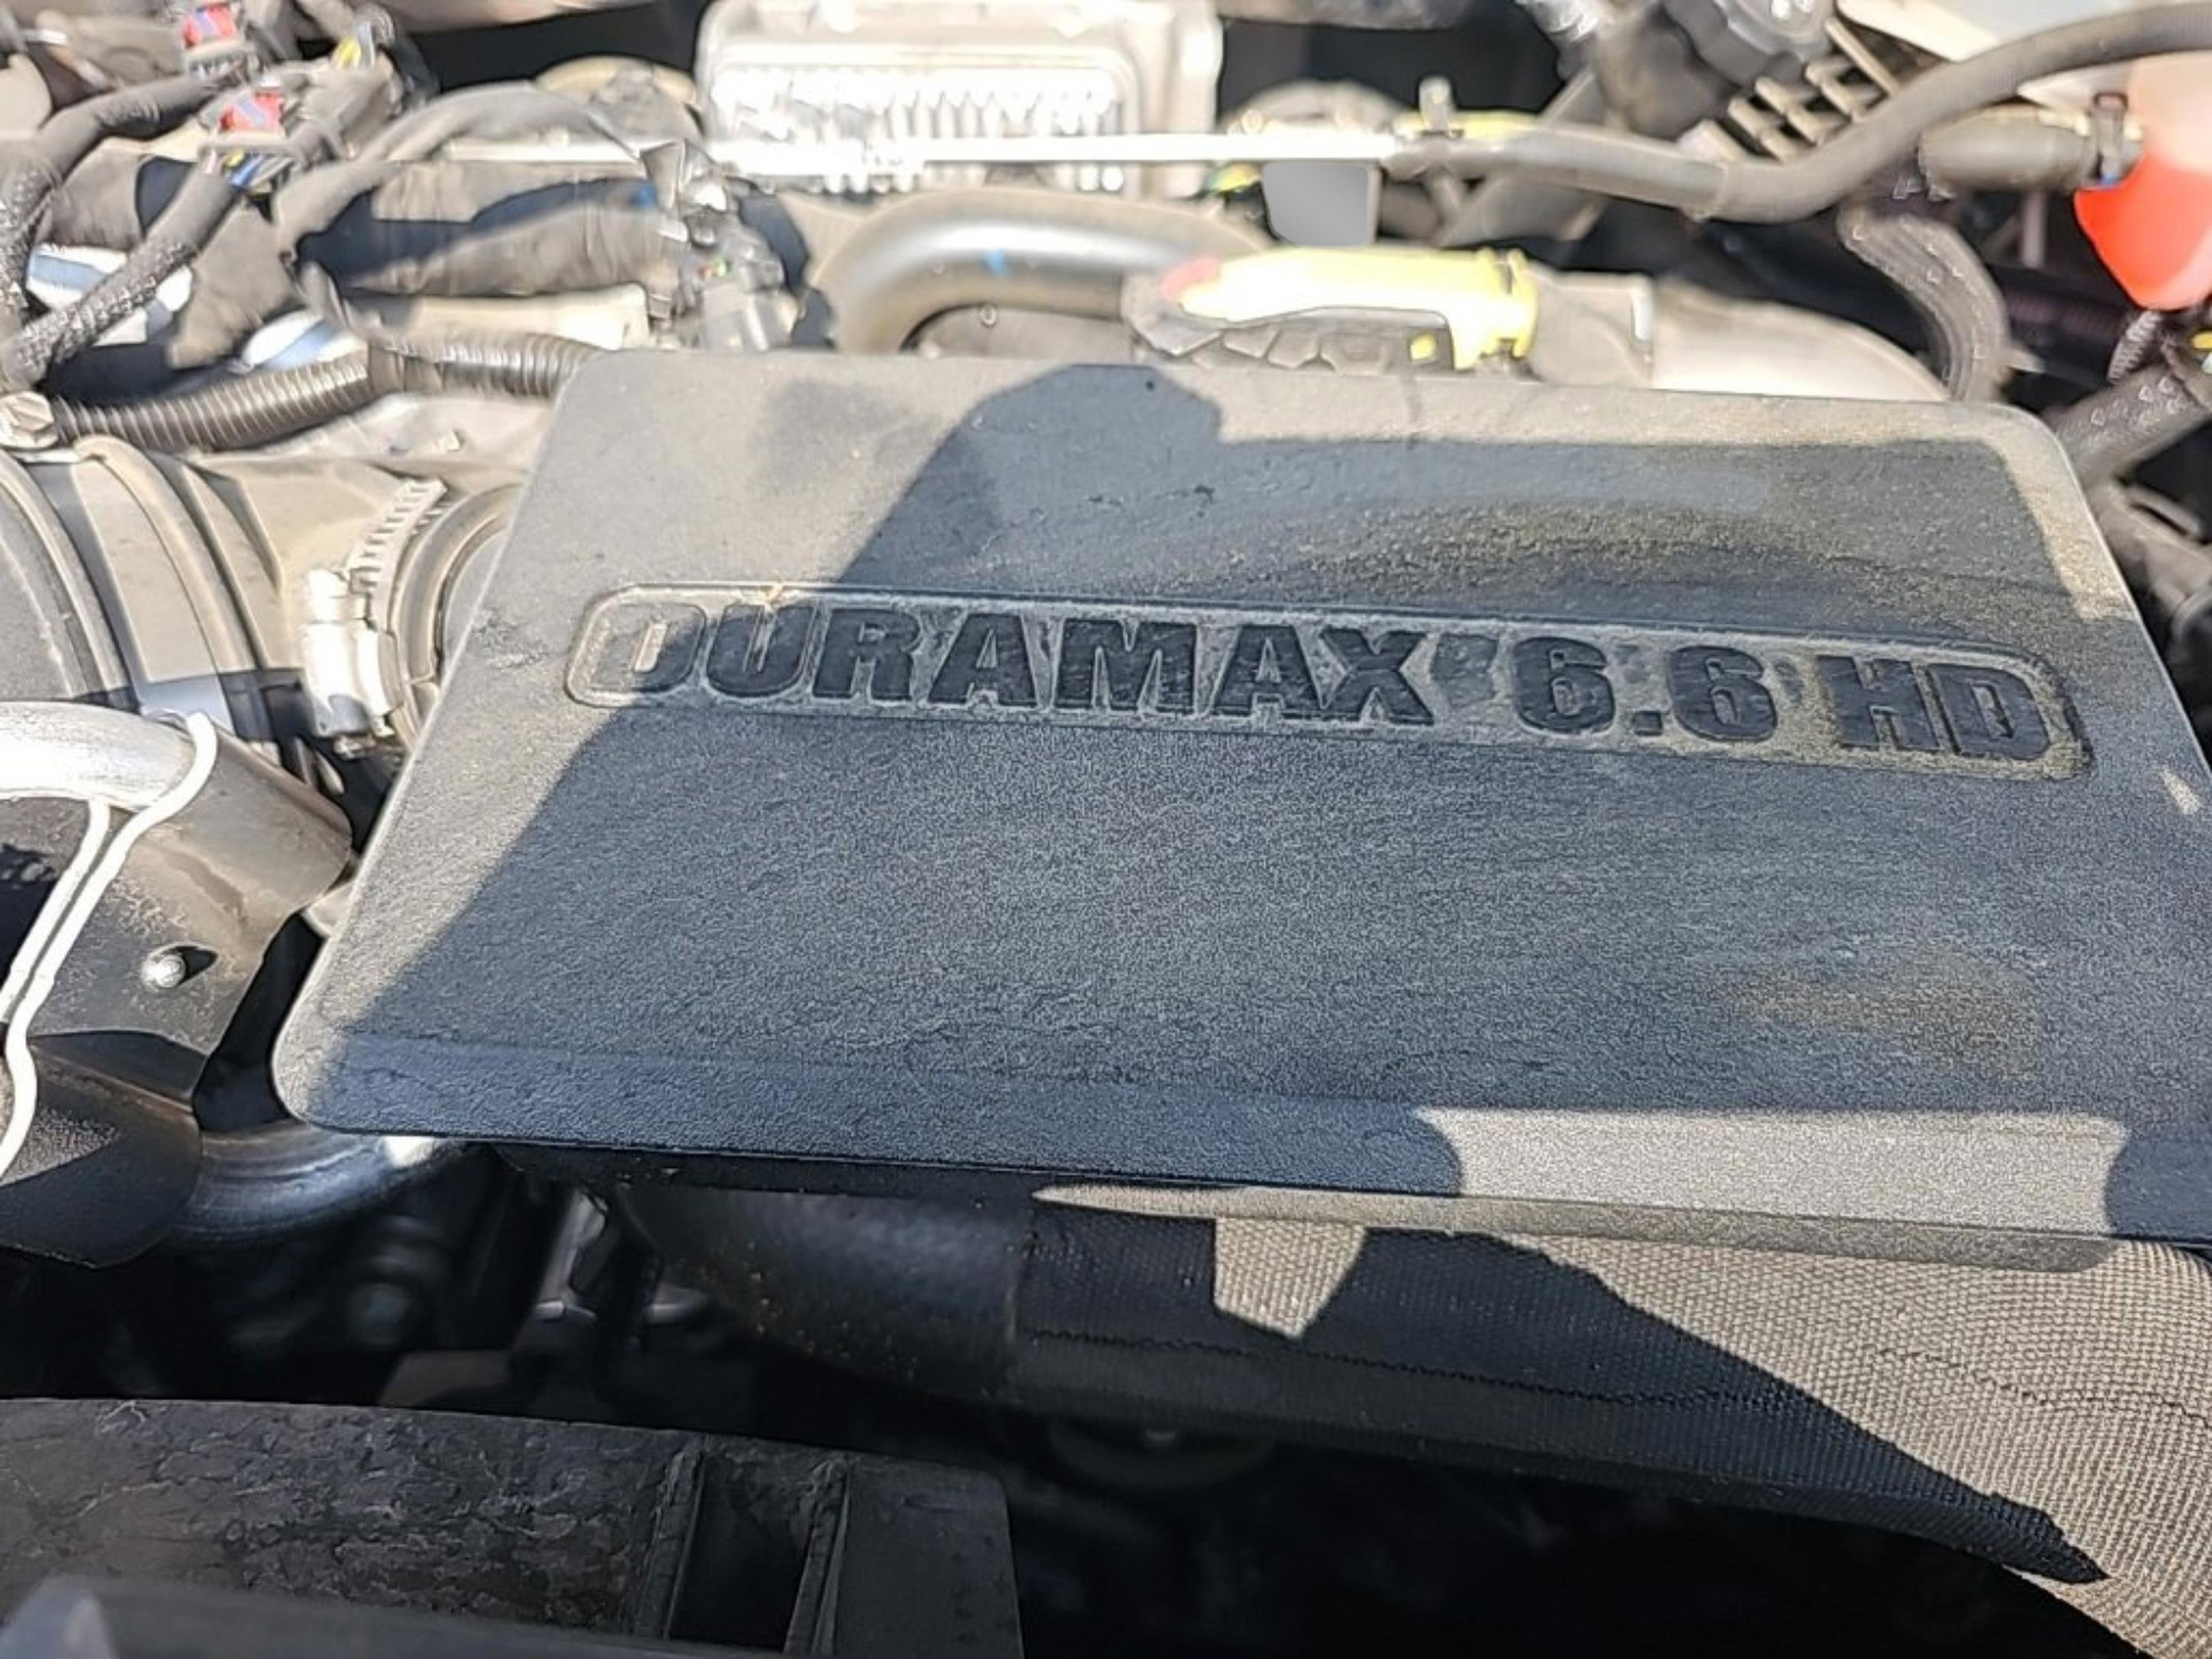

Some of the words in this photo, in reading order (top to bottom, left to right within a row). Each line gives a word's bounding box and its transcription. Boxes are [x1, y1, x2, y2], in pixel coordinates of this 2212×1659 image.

[588, 603, 1435, 725] DURAMAX
[1513, 636, 1778, 741] 6.6
[1816, 655, 2051, 761] HD
